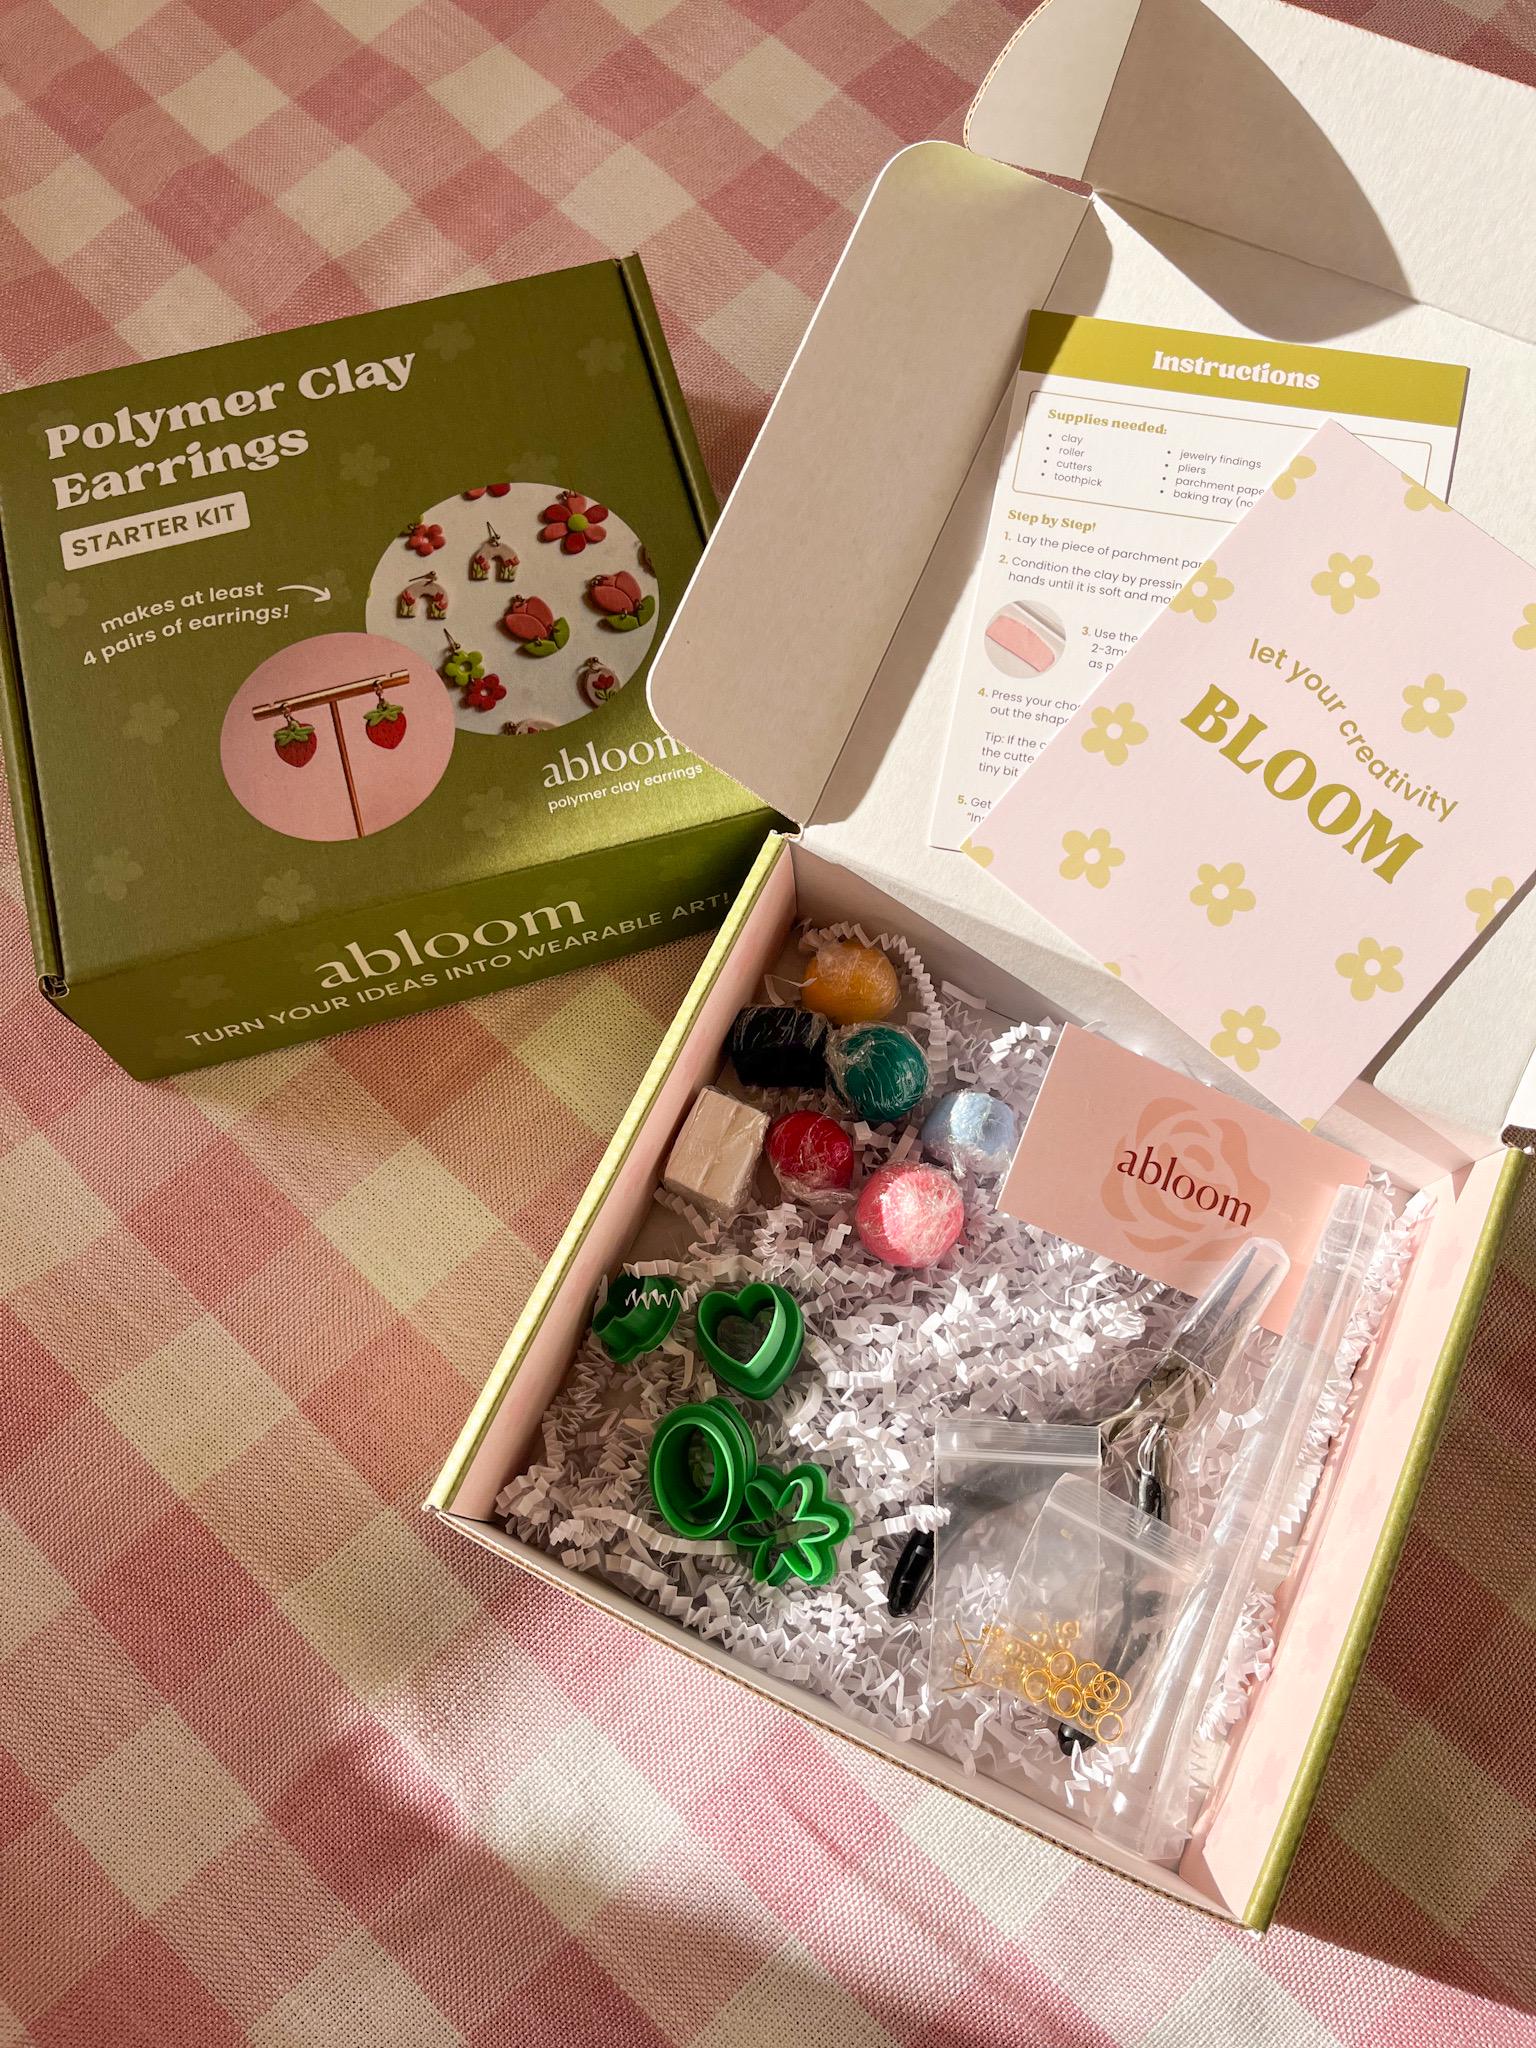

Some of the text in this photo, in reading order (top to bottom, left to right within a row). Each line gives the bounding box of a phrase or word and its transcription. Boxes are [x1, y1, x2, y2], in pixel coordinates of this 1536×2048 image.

[1152, 350, 1321, 390] Instructions
[44, 353, 416, 460] Polymer Clay
[1048, 409, 1167, 435] Supplies needed:
[1061, 434, 1083, 445] clay
[1058, 447, 1085, 458] roller
[1179, 449, 1262, 470] jewelry findings
[52, 428, 309, 511] Earrings
[1056, 460, 1093, 472] cutters
[1177, 464, 1206, 475] pliers
[1054, 473, 1102, 487] toothpick
[1175, 477, 1235, 492] parchment
[1173, 489, 1209, 504] baking
[1212, 495, 1233, 507] tray
[72, 503, 235, 557] STARTER KIT
[1008, 509, 1096, 534] Step by Step!
[1003, 531, 1011, 541] 1.
[1017, 533, 1037, 548] Lay
[1040, 537, 1059, 548] the
[1061, 541, 1095, 554] piece
[1097, 546, 1109, 556] of
[1111, 549, 1179, 566] parchment
[999, 554, 1009, 565] 2.
[1011, 556, 1069, 574] Condition
[1072, 565, 1091, 577] the
[1094, 569, 1120, 584] clay
[1121, 573, 1137, 586] by
[1008, 571, 1173, 604] hands until it is soft and ma
[100, 582, 264, 633] makes at least
[83, 604, 289, 666] 4 pairs of earrings!
[1094, 628, 1117, 640] Use
[1119, 632, 1138, 643] the
[1091, 643, 1127, 656] 2-3m
[1088, 660, 1103, 669] as
[977, 687, 1081, 711] 4. Press your cho
[990, 706, 1010, 717] out
[1013, 708, 1032, 720] the
[985, 731, 1004, 745] Tip:
[1007, 734, 1015, 744] If
[1017, 737, 1037, 748] the
[1249, 637, 1459, 823] let your creativity
[981, 747, 1001, 758] the
[978, 762, 1020, 777] tiny bit
[548, 764, 703, 813] polymer clay earrings
[1180, 683, 1424, 884] BLOOM
[957, 794, 992, 809] 5. Get
[314, 901, 585, 989] abloom
[185, 892, 729, 1046] TURN YOUR IDEAS INTO WEARABLE ART!
[1117, 1146, 1252, 1227] abloom
